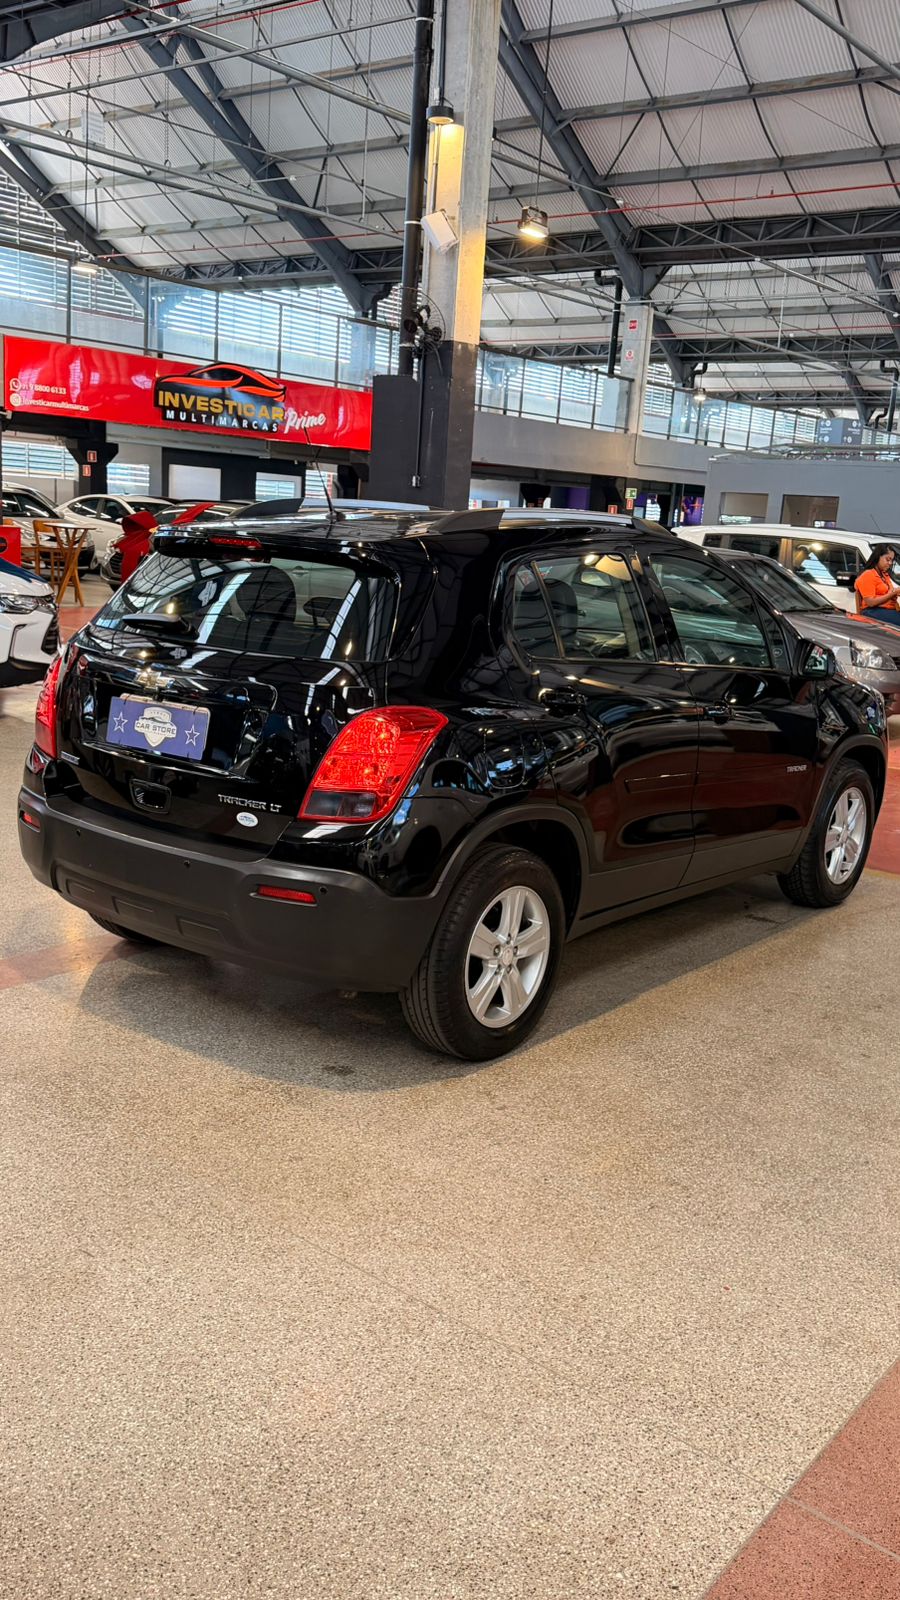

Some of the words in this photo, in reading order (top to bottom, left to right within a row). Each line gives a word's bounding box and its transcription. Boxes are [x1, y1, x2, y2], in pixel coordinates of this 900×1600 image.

[158, 390, 285, 421] INVESTICAR
[165, 410, 278, 432] MULTIMARCAS
[284, 411, 327, 434] Prime
[135, 721, 150, 731] CAR
[152, 725, 176, 735] STORE
[217, 793, 268, 811] TRACKER
[270, 803, 283, 813] LT
